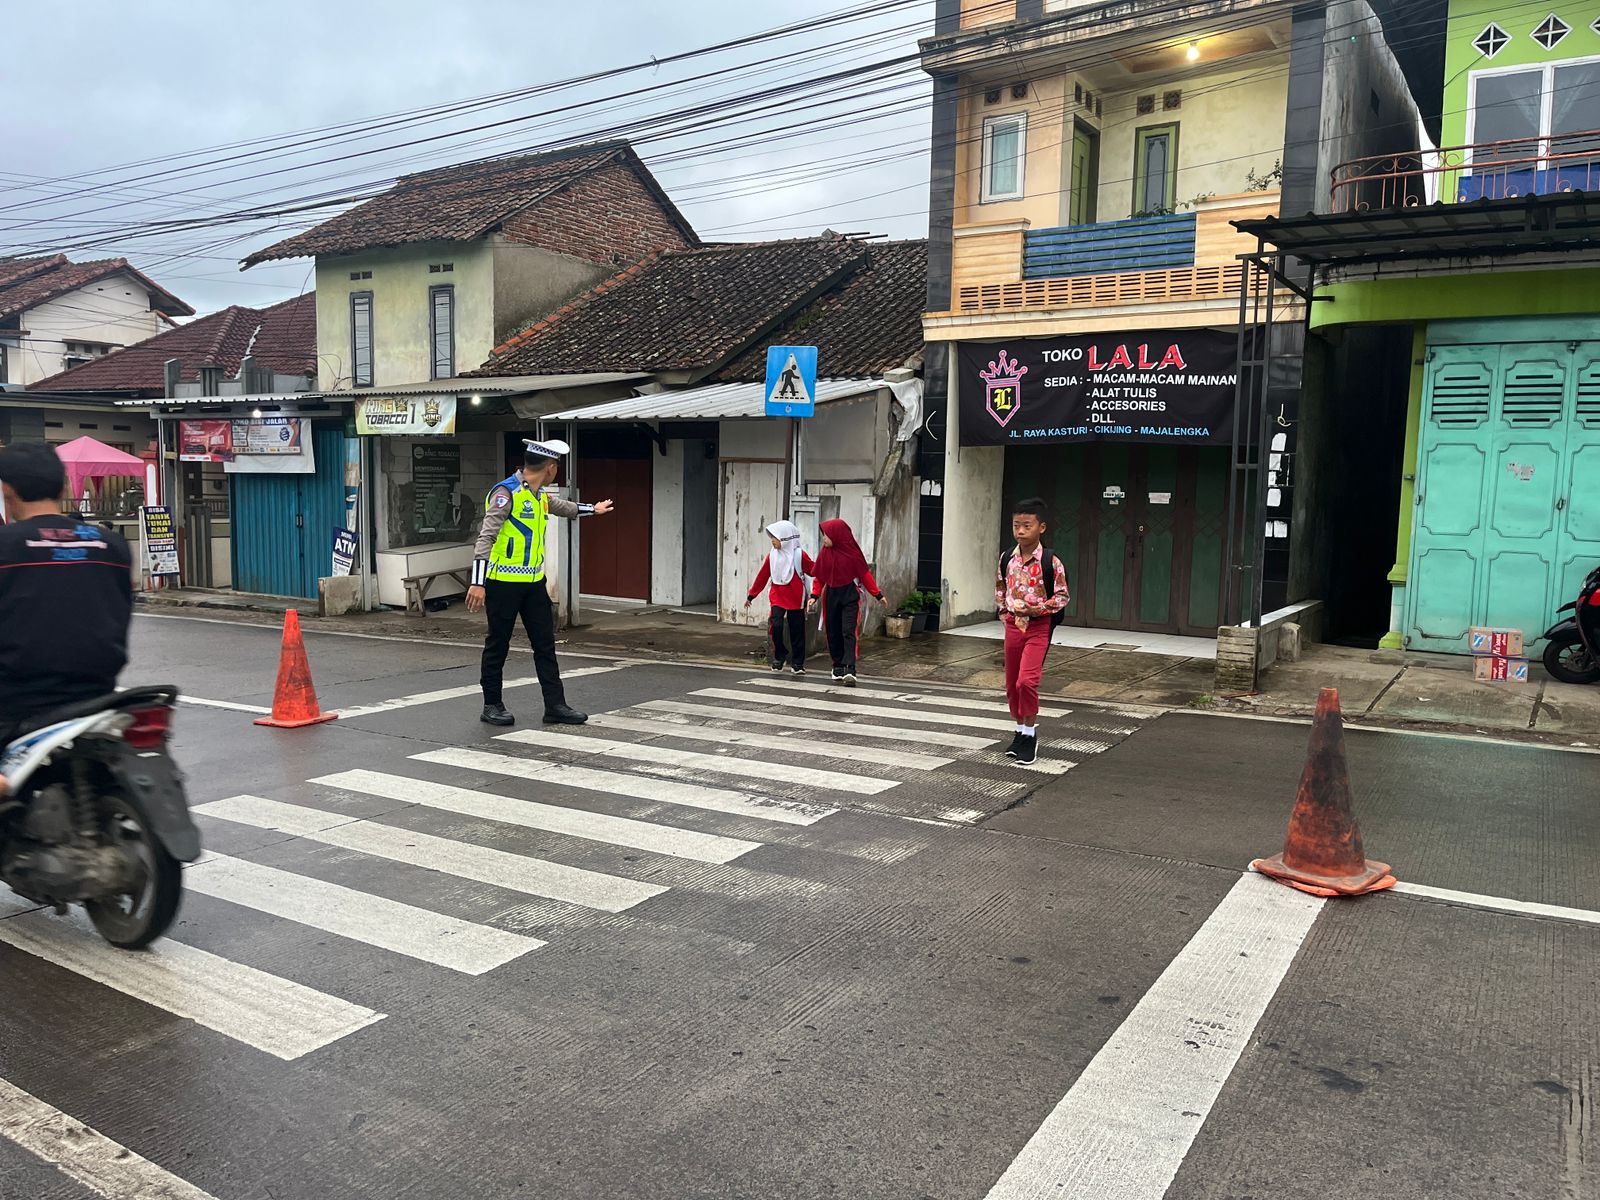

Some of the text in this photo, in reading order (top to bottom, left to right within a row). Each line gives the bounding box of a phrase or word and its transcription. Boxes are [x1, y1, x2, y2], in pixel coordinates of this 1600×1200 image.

[1042, 343, 1188, 372] TOKO LALA
[1093, 373, 1186, 385] MACAM-MACAM
[1188, 374, 1238, 386] MAINAN
[1123, 387, 1157, 398] TULIS
[365, 400, 394, 413] KING
[1091, 400, 1167, 411] ACCESORIES
[365, 413, 409, 425] TOBACCO
[1023, 429, 1047, 438] RAYA
[1048, 426, 1088, 437] KASTURI
[1094, 425, 1132, 434] CIKIJING
[1140, 426, 1210, 436] MAJALENGKA
